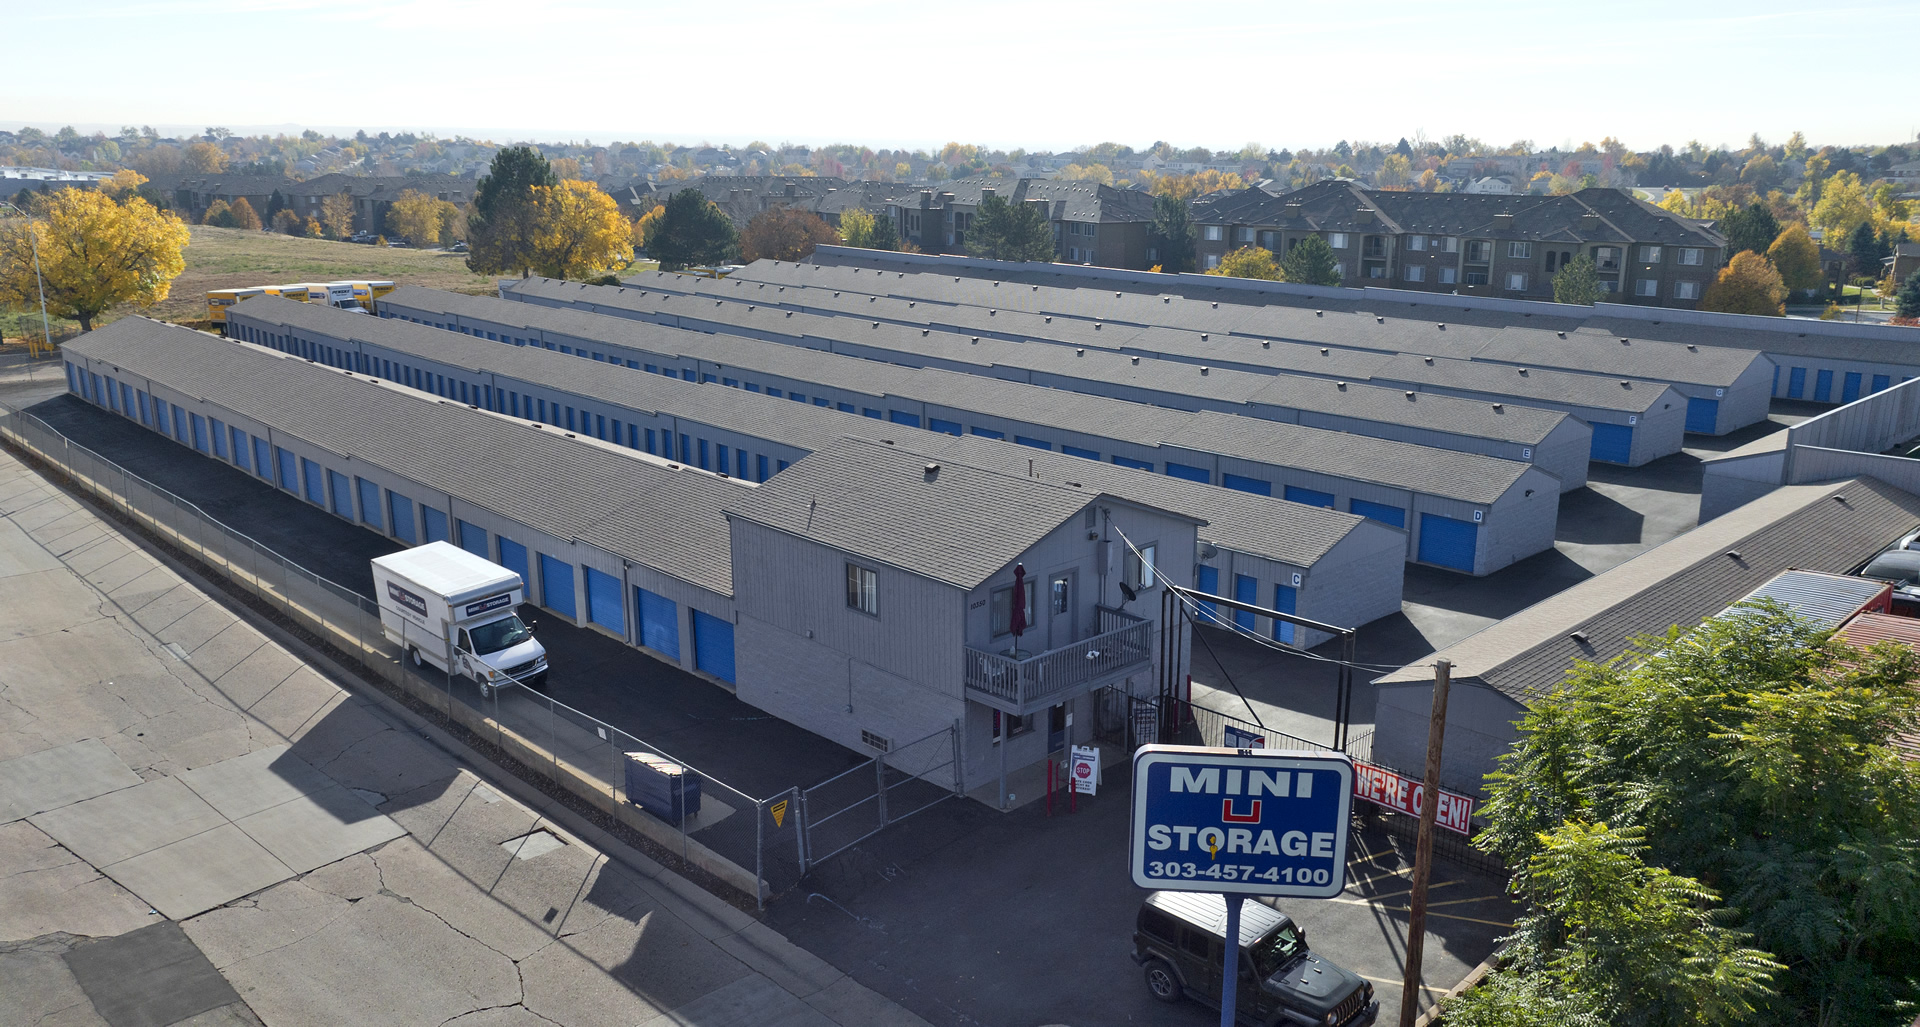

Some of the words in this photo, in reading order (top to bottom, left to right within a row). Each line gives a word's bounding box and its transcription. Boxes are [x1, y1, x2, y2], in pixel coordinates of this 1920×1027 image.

[1524, 449, 1530, 457] E
[1475, 511, 1482, 520] D
[1293, 575, 1300, 584] C
[405, 594, 426, 611] STORAGE
[486, 597, 509, 608] STORAGE
[1169, 766, 1314, 798] MINI
[1356, 765, 1410, 810] WE'RE
[1412, 785, 1468, 830] OEN!
[1147, 824, 1335, 858] STORAGE
[1149, 861, 1329, 884] 303-457-4100
